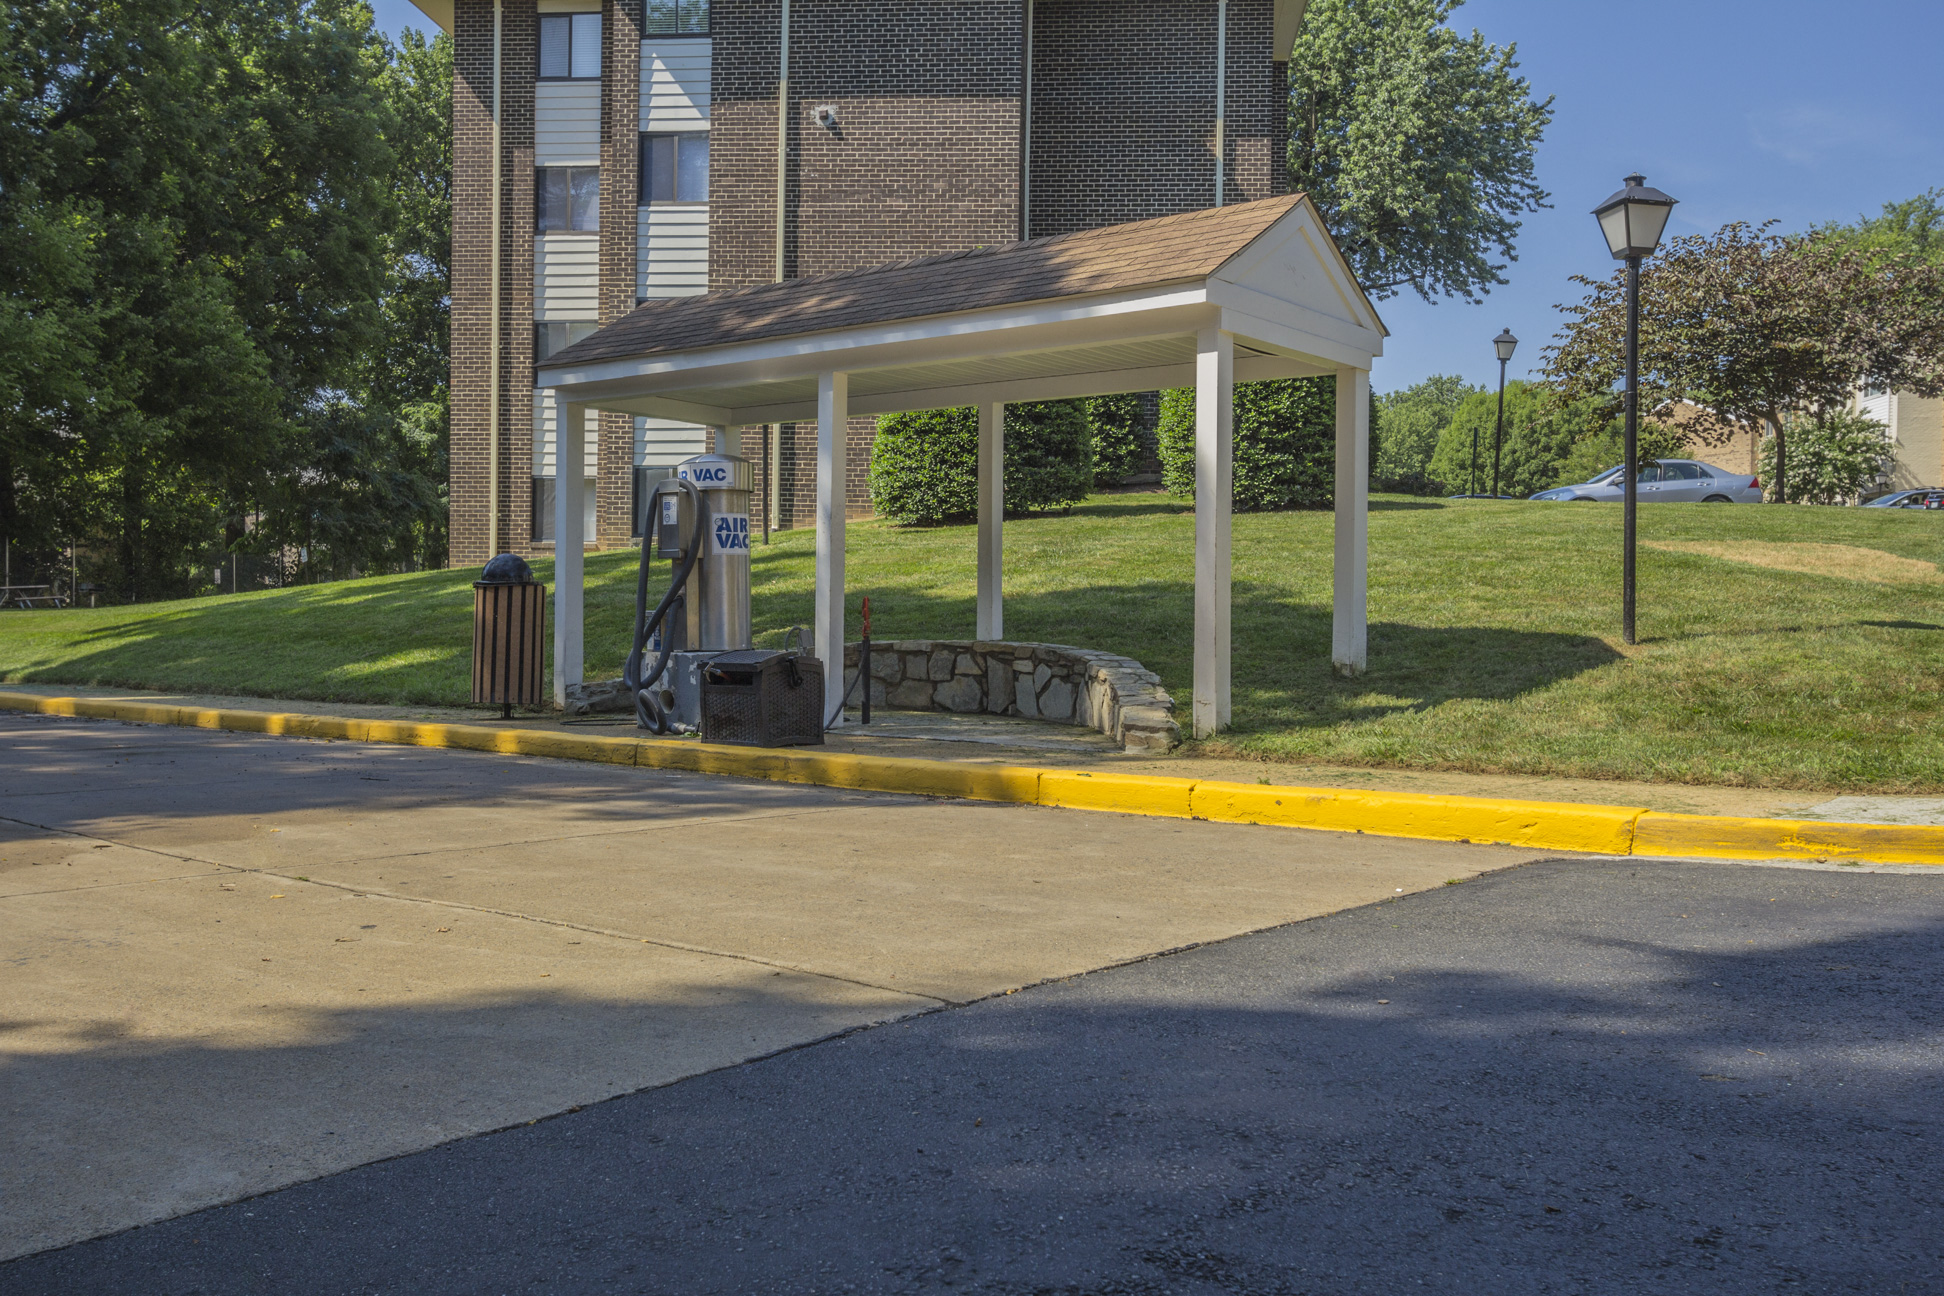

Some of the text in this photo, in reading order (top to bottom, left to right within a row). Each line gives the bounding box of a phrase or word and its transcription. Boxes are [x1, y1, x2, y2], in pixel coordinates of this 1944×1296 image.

[693, 468, 726, 481] VAC
[715, 517, 748, 533] AIR
[715, 533, 748, 549] VAC
